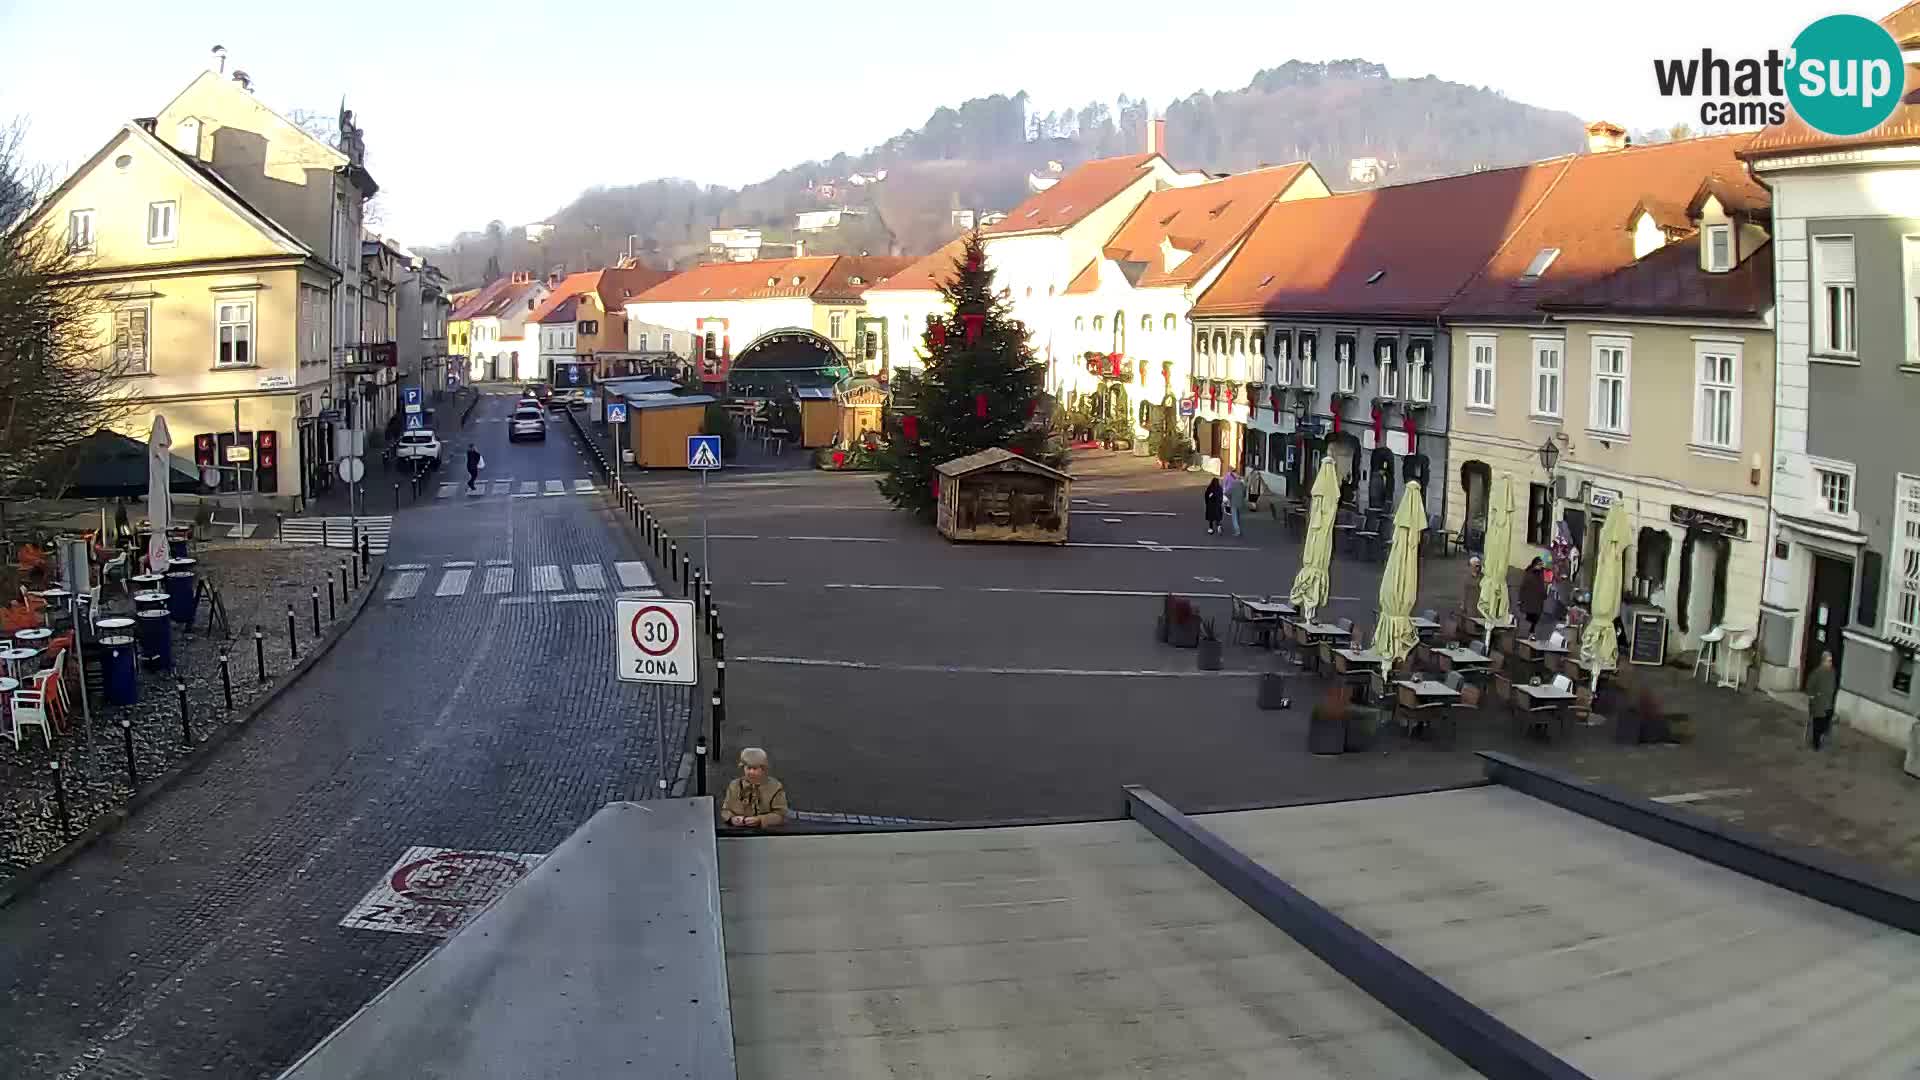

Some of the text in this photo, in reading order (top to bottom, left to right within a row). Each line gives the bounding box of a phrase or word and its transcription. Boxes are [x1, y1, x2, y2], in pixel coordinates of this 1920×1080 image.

[408, 391, 417, 402] P
[644, 621, 668, 643] 30
[634, 659, 679, 675] ZONA
